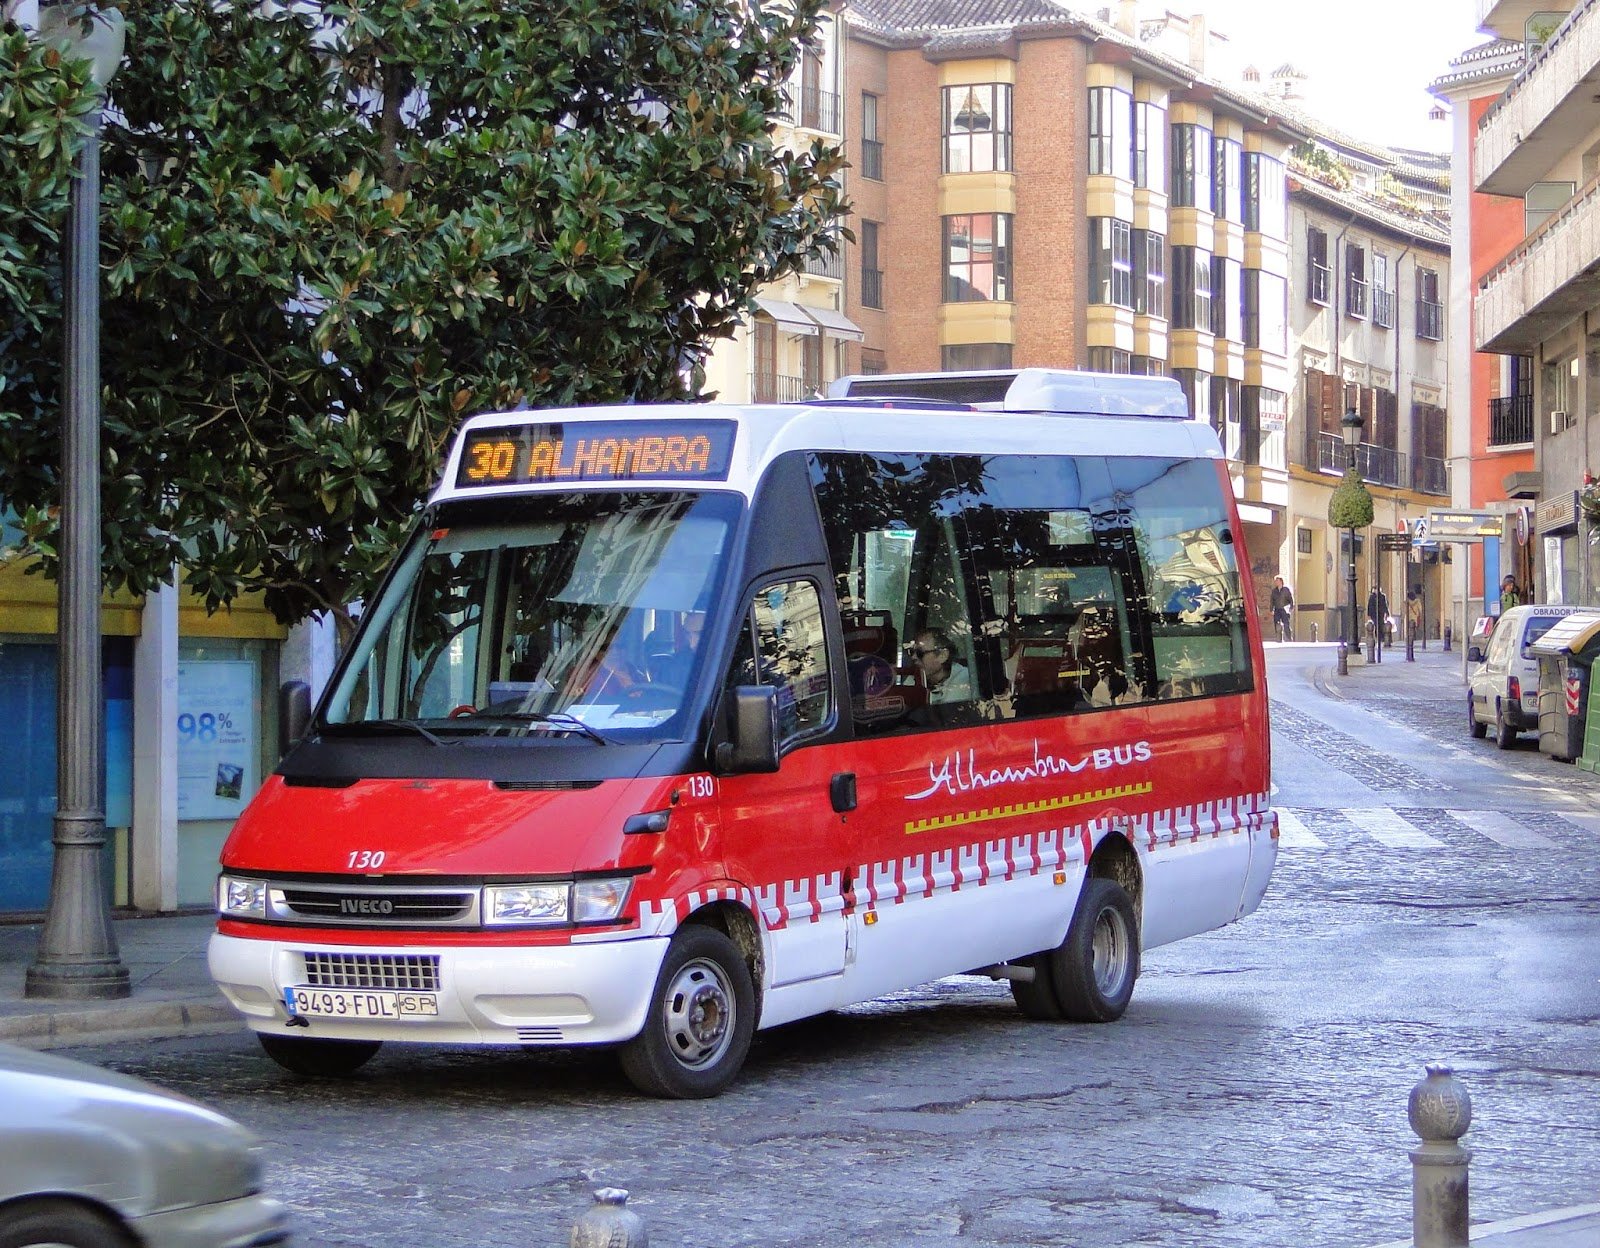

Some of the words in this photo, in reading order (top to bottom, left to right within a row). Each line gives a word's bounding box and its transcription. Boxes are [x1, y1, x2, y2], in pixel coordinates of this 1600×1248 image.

[468, 442, 516, 479] 30
[528, 435, 711, 477] ALHAMBRA
[1533, 608, 1571, 616] OBRADOR
[904, 737, 1089, 800] Alhambra
[1092, 740, 1153, 770] BUS
[689, 775, 714, 797] 130
[347, 850, 386, 869] 130
[340, 899, 394, 914] IVECO
[297, 992, 347, 1014] 9493
[354, 994, 393, 1017] FDL
